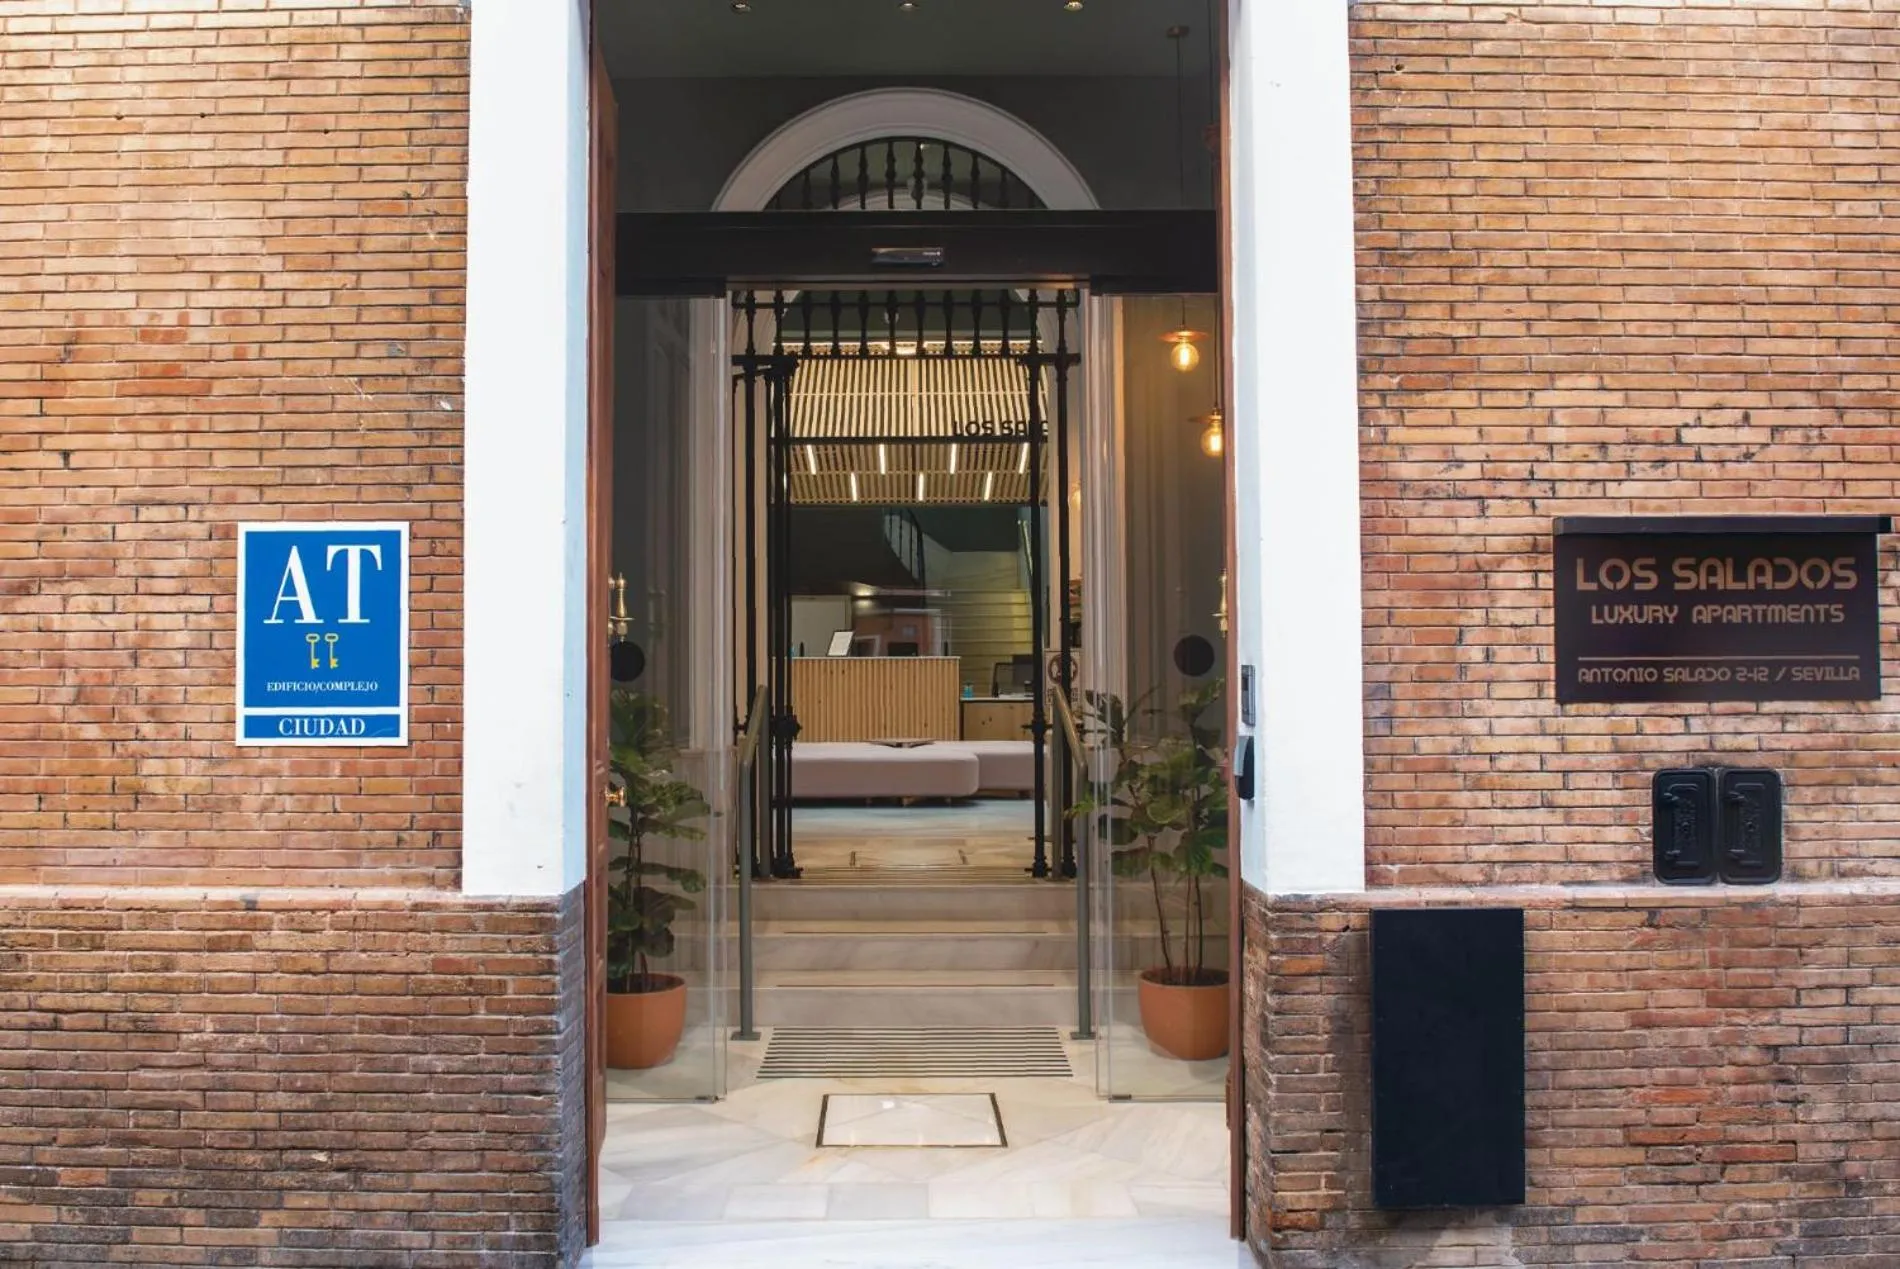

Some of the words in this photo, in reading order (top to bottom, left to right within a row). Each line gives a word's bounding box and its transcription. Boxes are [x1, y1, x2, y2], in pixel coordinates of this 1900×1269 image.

[953, 420, 994, 436] LOS
[1576, 557, 1658, 591] LOS
[1671, 556, 1858, 591] SALADOS
[263, 544, 383, 624] AT
[1591, 605, 1679, 624] LUXURY
[1692, 604, 1845, 624] APARTMENTS
[1577, 667, 1658, 683] ANTONIO
[1663, 667, 1731, 682] SALADO
[1791, 666, 1861, 682] SEVILLA
[266, 680, 379, 694] EDIFICIO/COMPLEJO
[277, 717, 366, 736] CIUDAD
